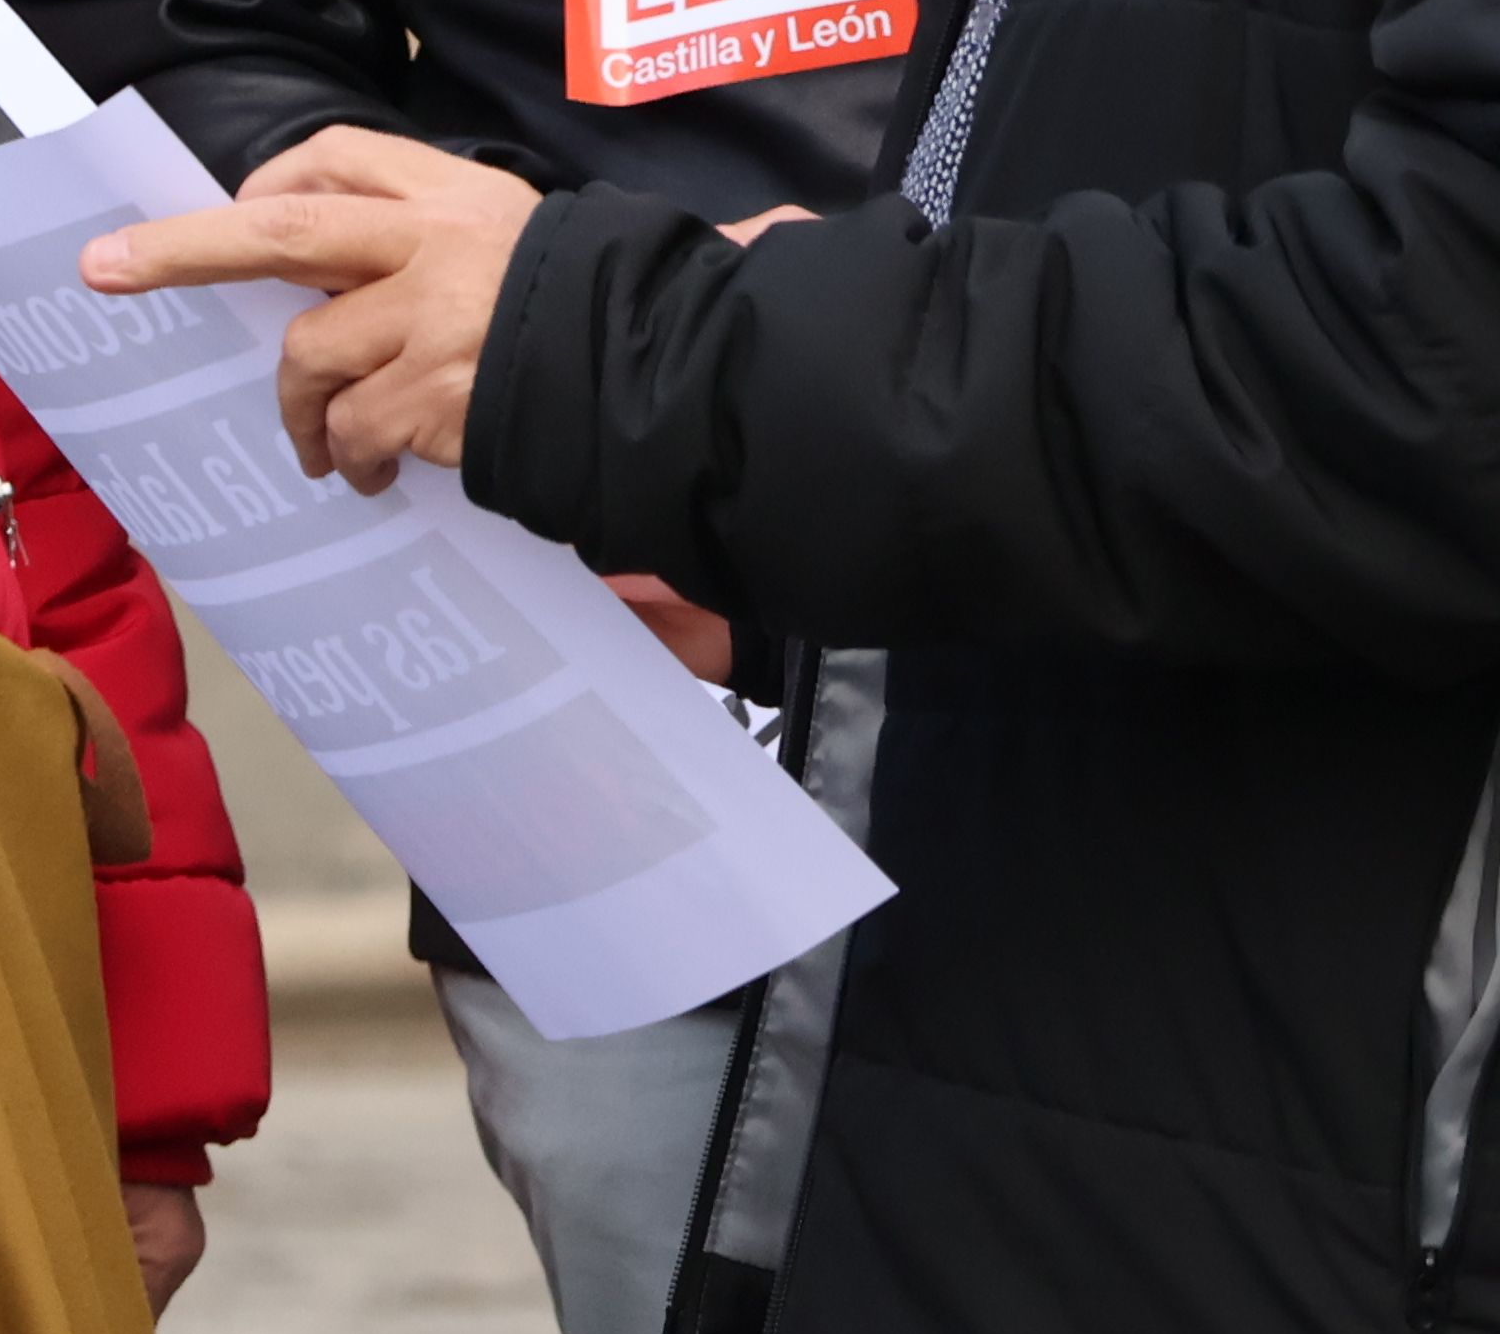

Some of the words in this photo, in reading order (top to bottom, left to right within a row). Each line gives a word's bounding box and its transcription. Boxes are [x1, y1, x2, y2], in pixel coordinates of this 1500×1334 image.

[601, 33, 744, 88] Castilla
[752, 28, 776, 68] y
[786, 4, 892, 53] León
